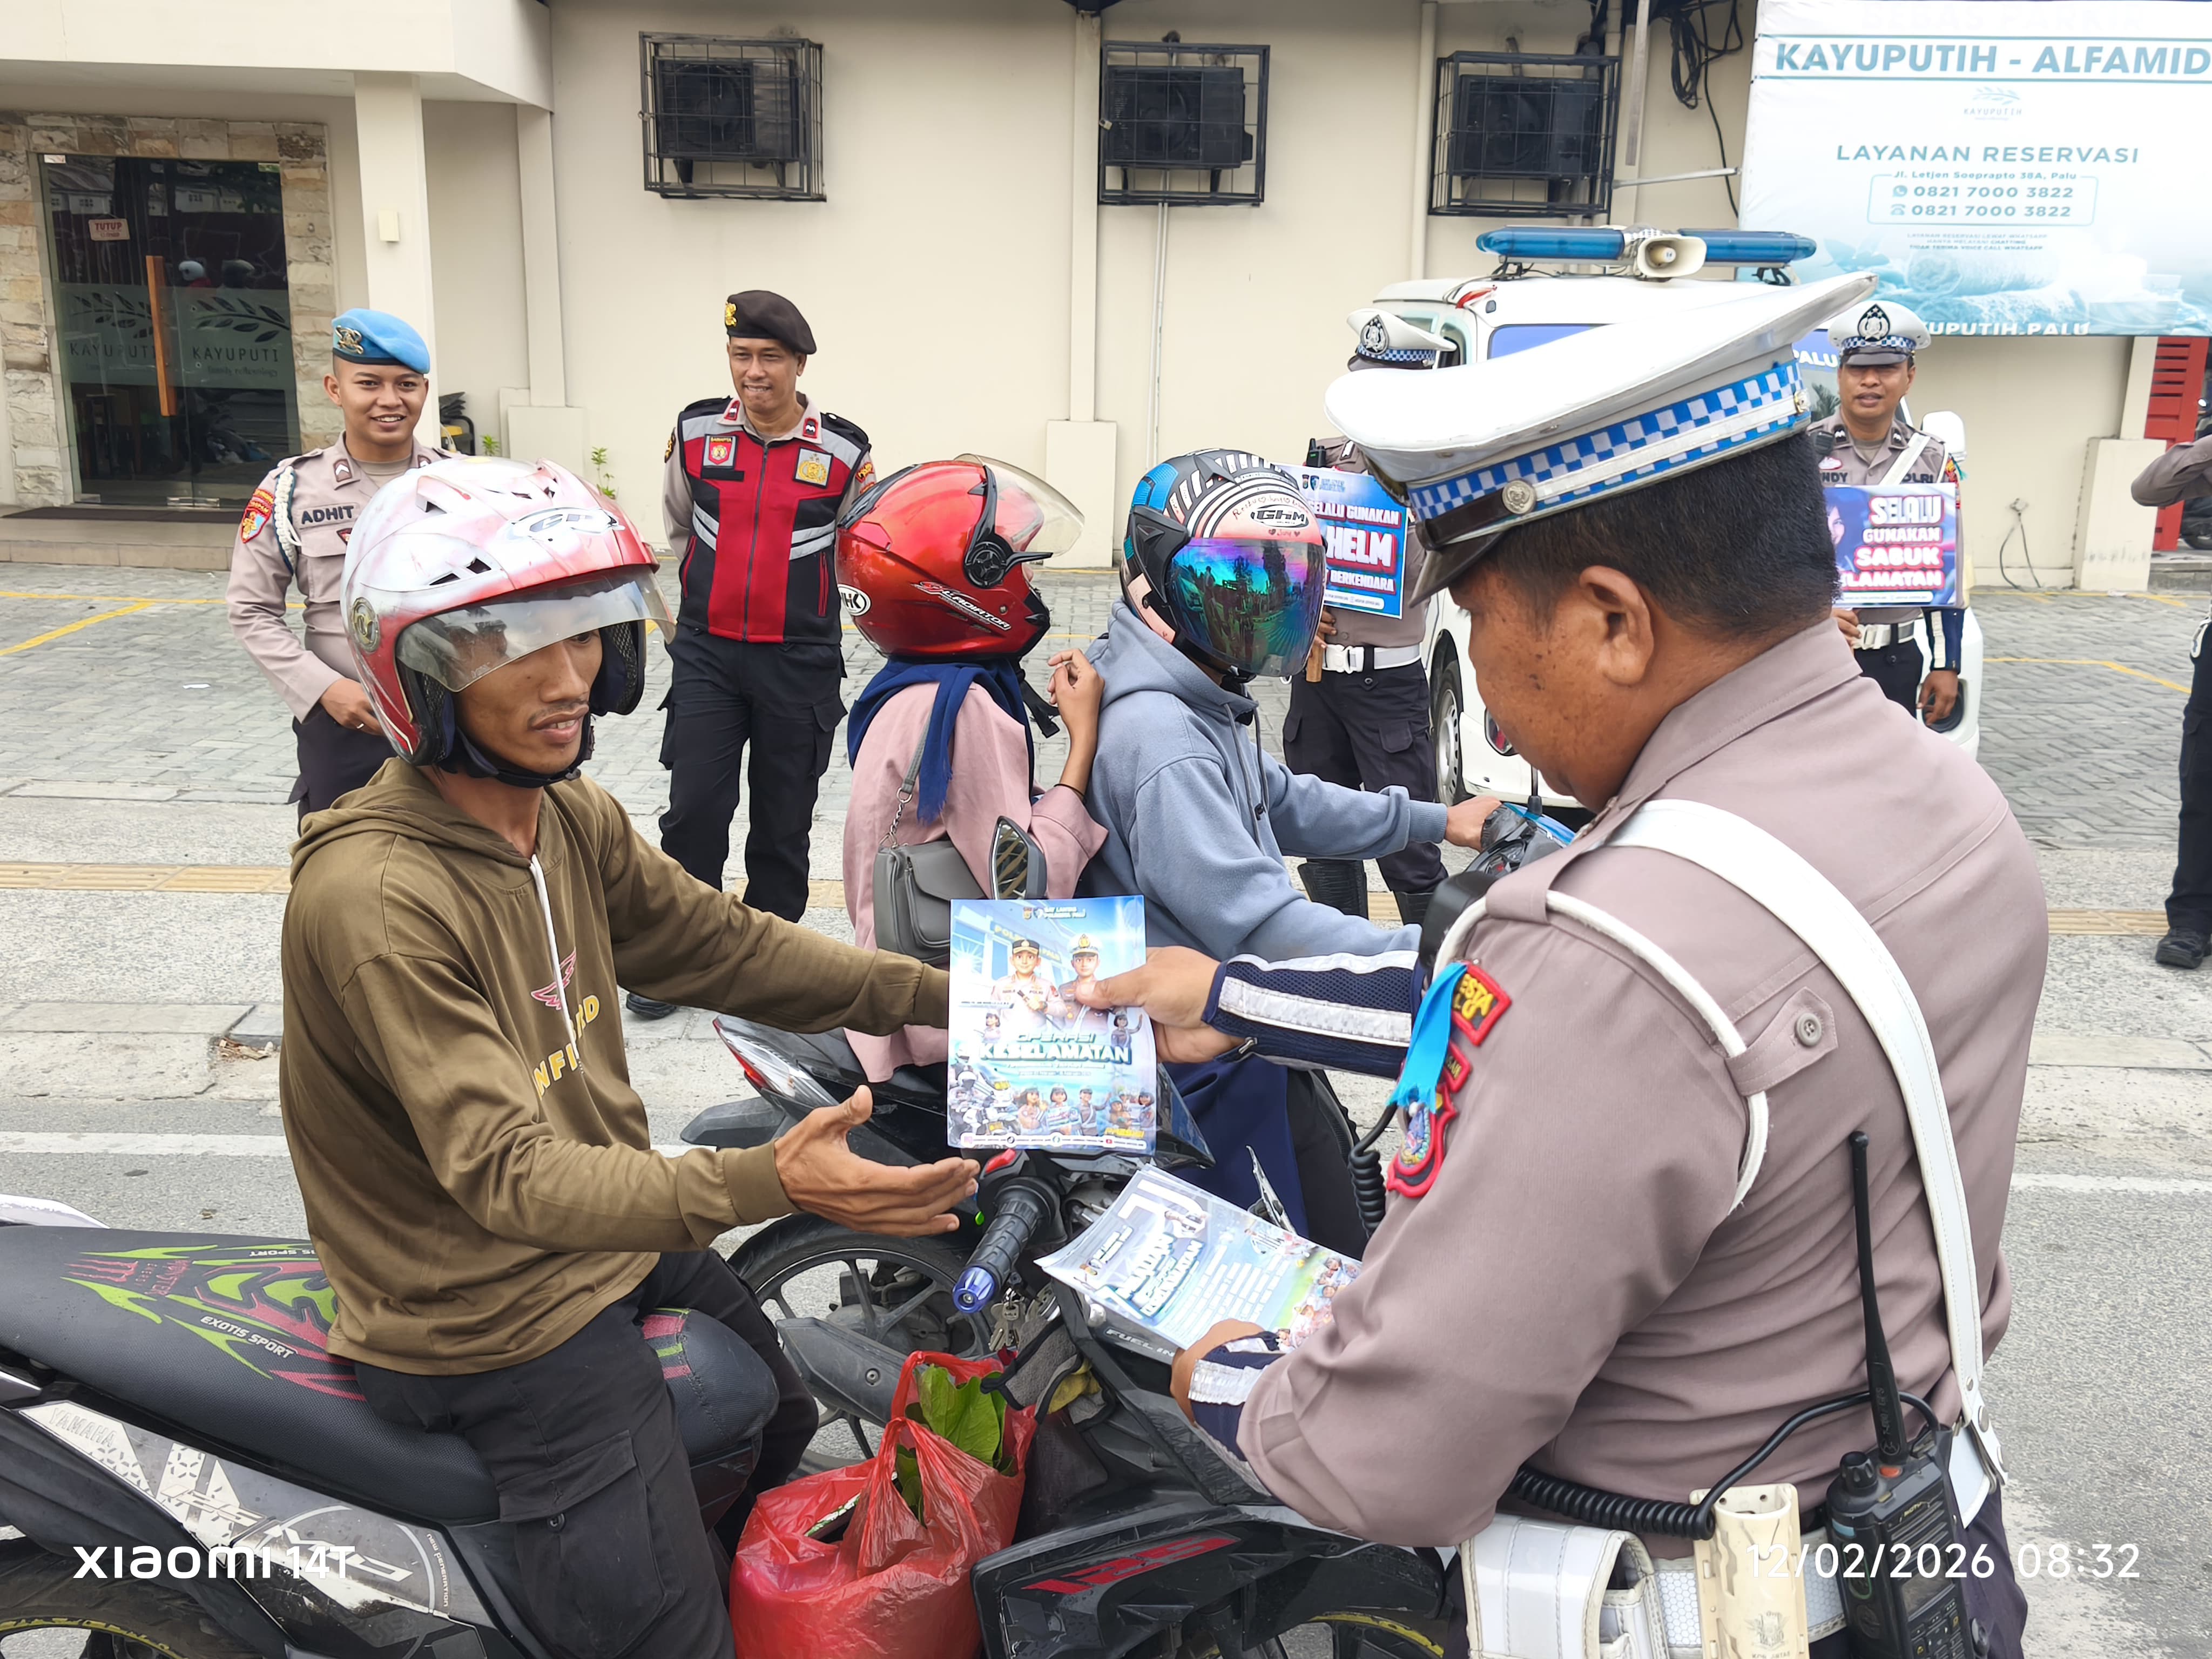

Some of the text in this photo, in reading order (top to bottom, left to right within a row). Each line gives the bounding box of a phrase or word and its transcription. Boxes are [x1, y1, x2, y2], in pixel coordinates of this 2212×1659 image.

[1775, 43, 1998, 73] KAYUPUTIH
[1964, 107, 2022, 116] KAYUPUTIH
[1837, 145, 2139, 163] LAYANAN RESERVASI
[1912, 170, 1949, 180] Letjen
[2051, 171, 2077, 180] Palu
[1913, 186, 2074, 198] 0821 7000 3822
[1911, 205, 2072, 218] 0821 7000 3822
[95, 221, 123, 231] TUTUP
[1923, 322, 2090, 335] UPUTIH.PALU
[1822, 472, 1848, 483] NDY
[1903, 473, 1934, 483] OLRI
[301, 505, 355, 525] ADHIT
[1346, 505, 1400, 526] GUNAKAN
[1870, 495, 1943, 525] SELALU
[1863, 527, 1941, 543] GUNAKAN
[1326, 525, 1393, 568] HELM
[1856, 546, 1941, 567] SABUK
[1330, 569, 1395, 592] BERKENDARA
[1841, 570, 1942, 588] LAMATAN
[980, 1043, 1132, 1065] KESELAMATAN
[200, 1316, 294, 1359] EXOTIS SPORT
[1106, 1328, 1176, 1357] FUEL IN
[48, 1407, 118, 1448] YAMAHA
